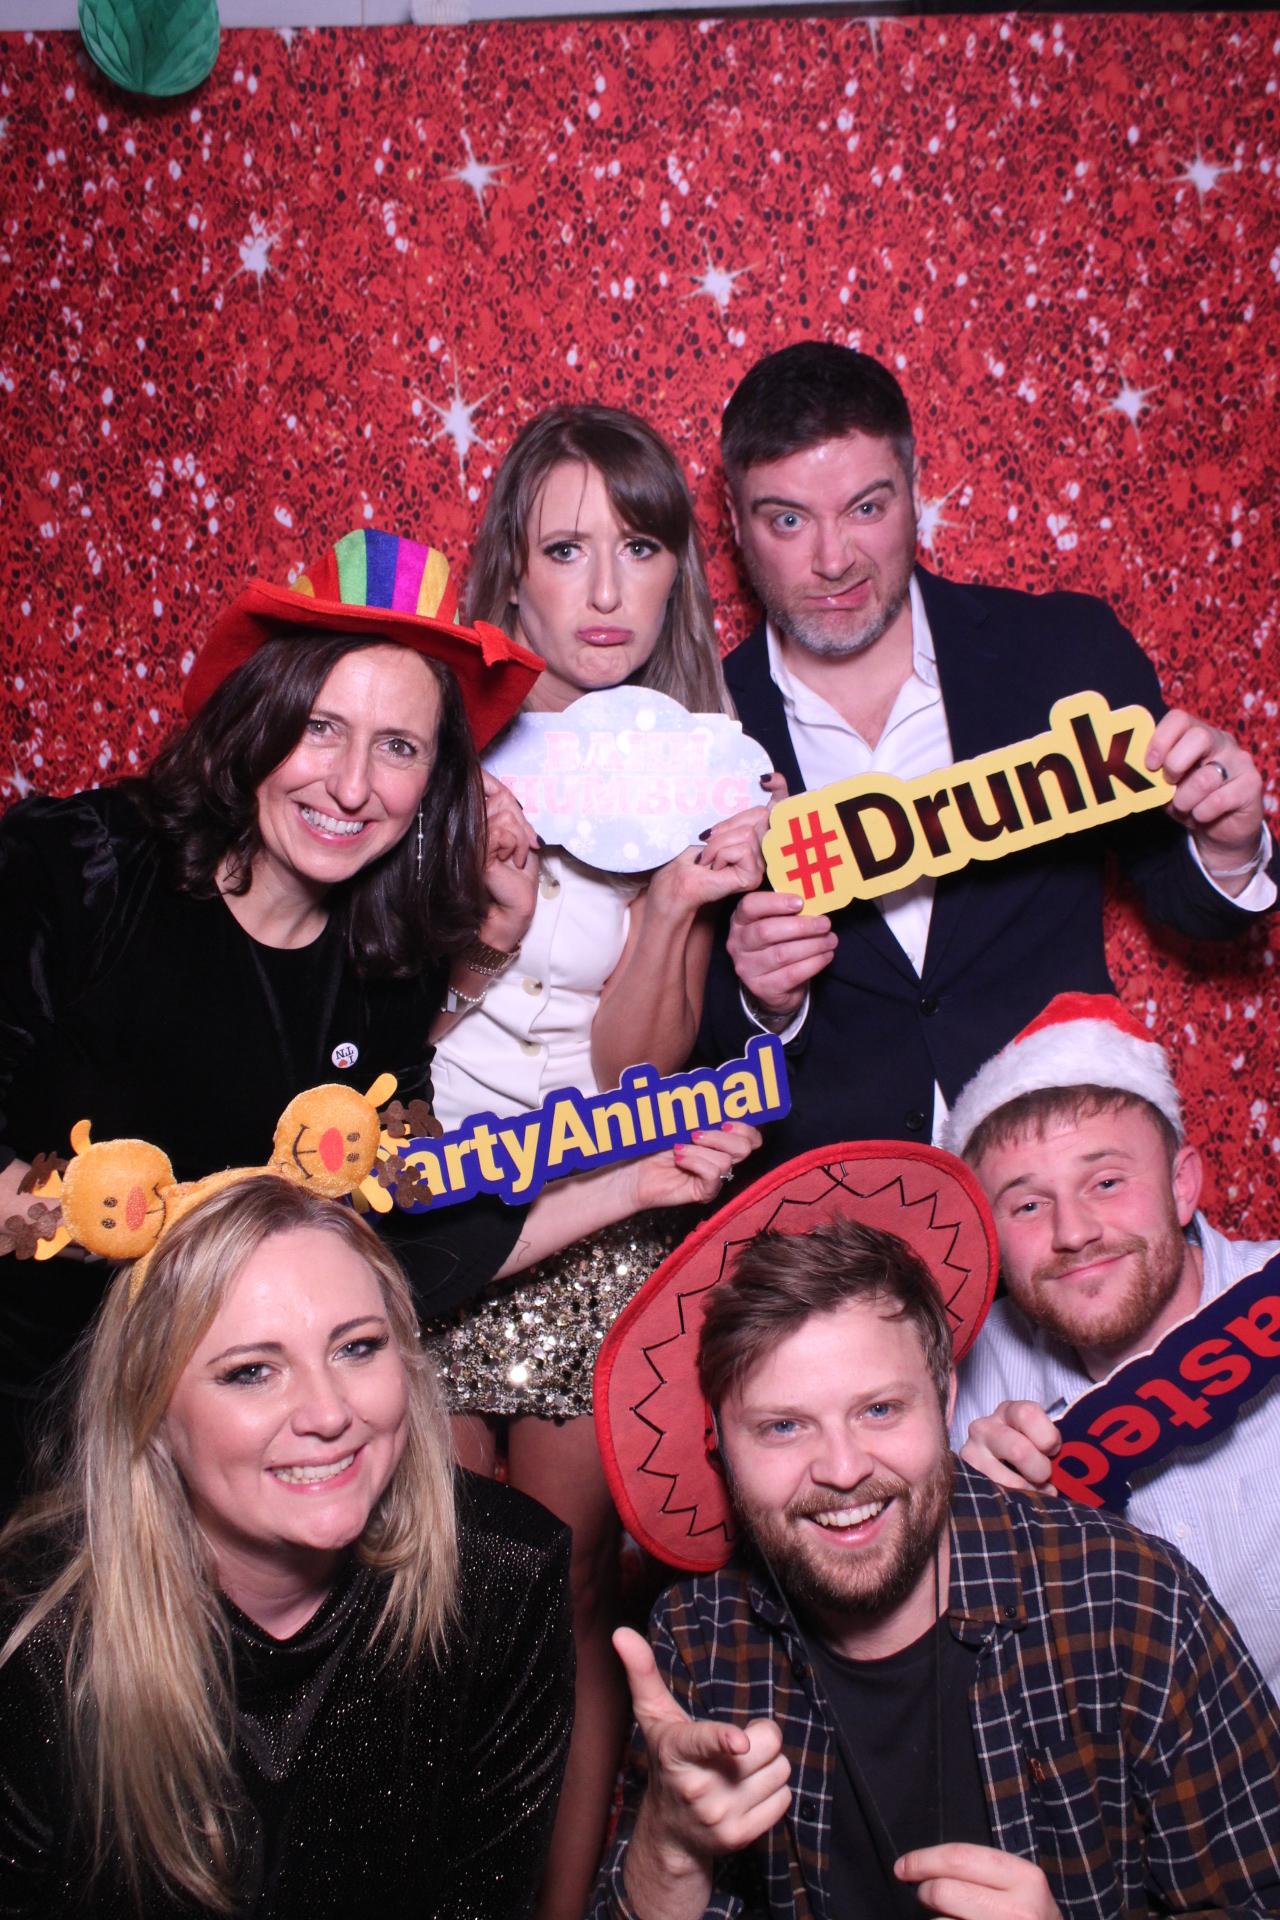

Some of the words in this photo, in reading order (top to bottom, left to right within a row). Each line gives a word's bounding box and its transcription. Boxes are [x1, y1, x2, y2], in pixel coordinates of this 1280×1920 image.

[499, 774, 752, 817] HUMBUG
[780, 713, 1157, 900] #Drunk
[376, 1045, 781, 1197] artyAnimal
